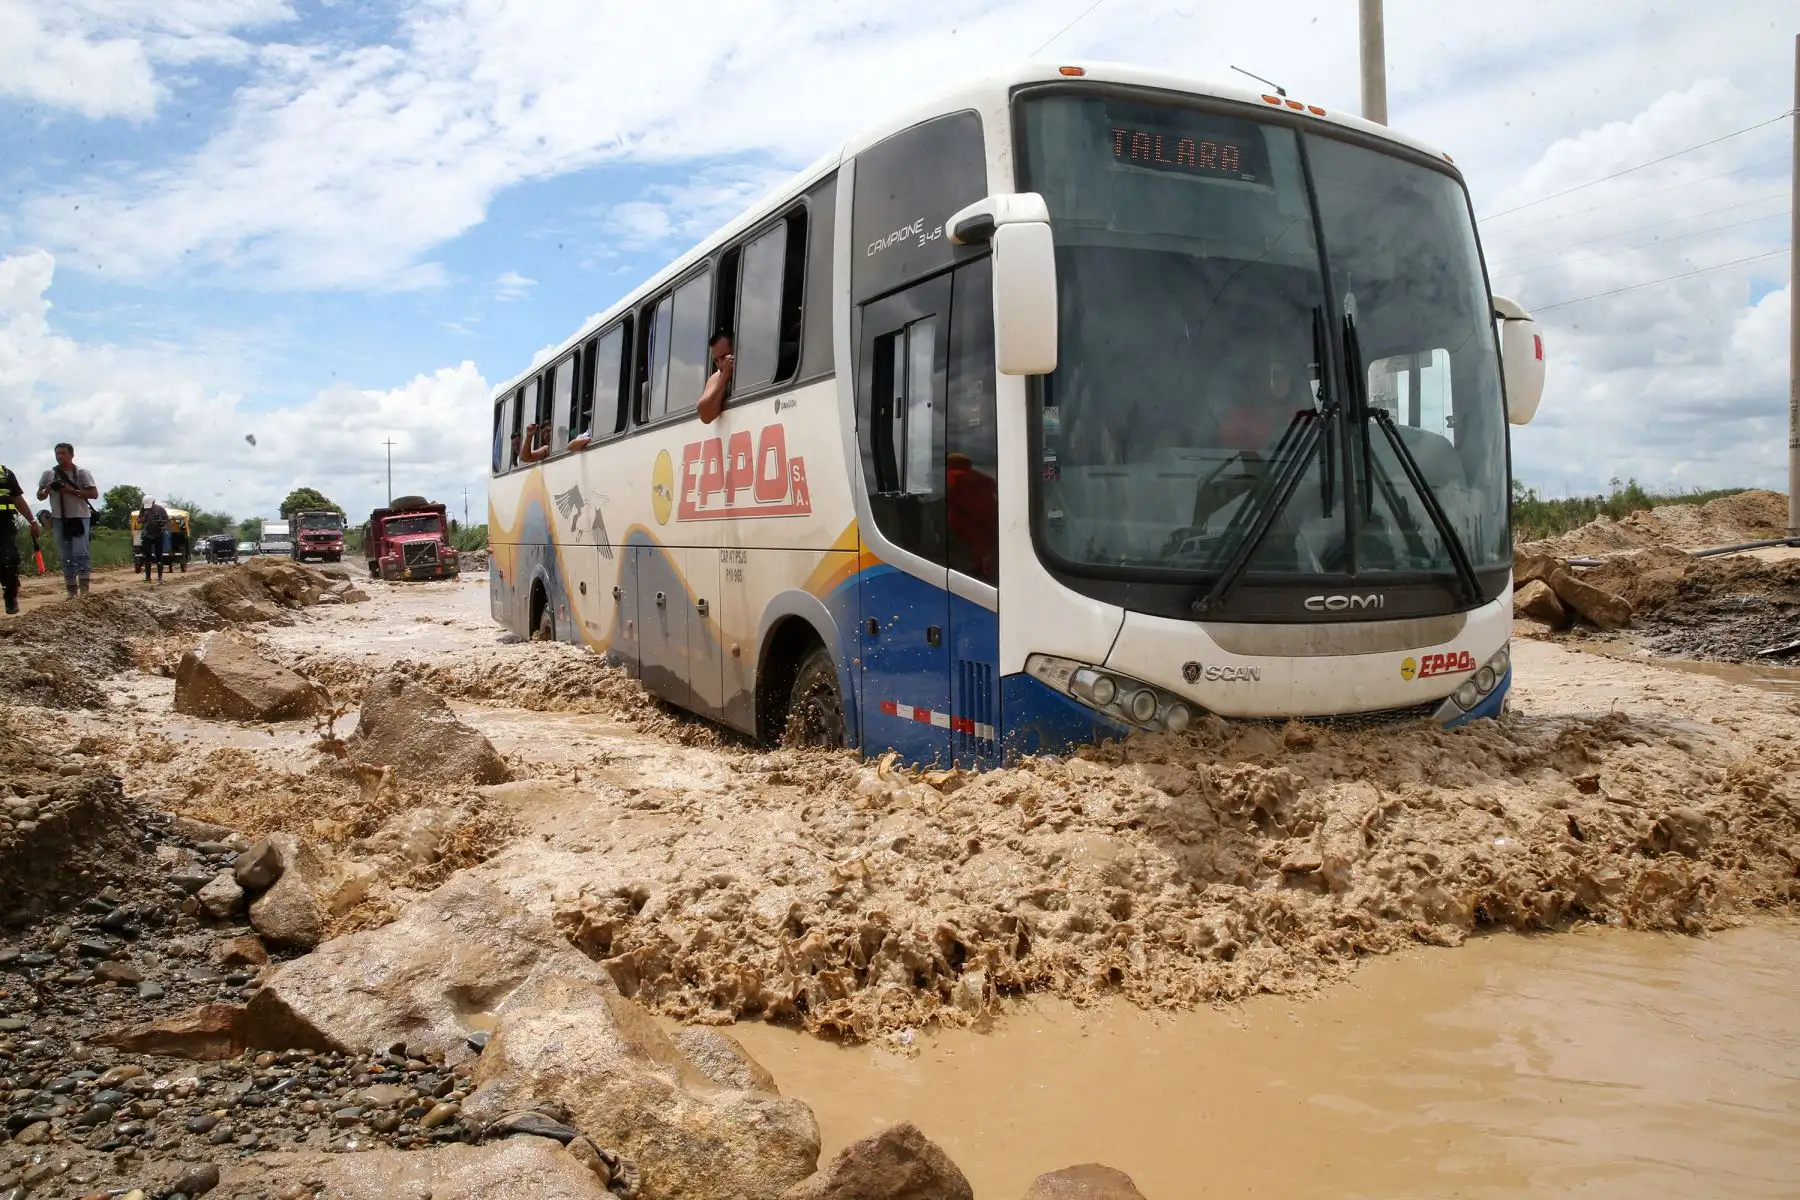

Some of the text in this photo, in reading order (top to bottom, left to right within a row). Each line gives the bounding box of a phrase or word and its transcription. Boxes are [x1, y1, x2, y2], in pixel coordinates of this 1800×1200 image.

[1112, 128, 1241, 172] TALARA
[867, 217, 925, 257] CAMPIONE
[917, 225, 942, 248] 345
[676, 422, 790, 522] EPPO
[1304, 594, 1384, 611] COMI
[1204, 664, 1261, 682] SCAN
[1418, 650, 1470, 678] EPPO
